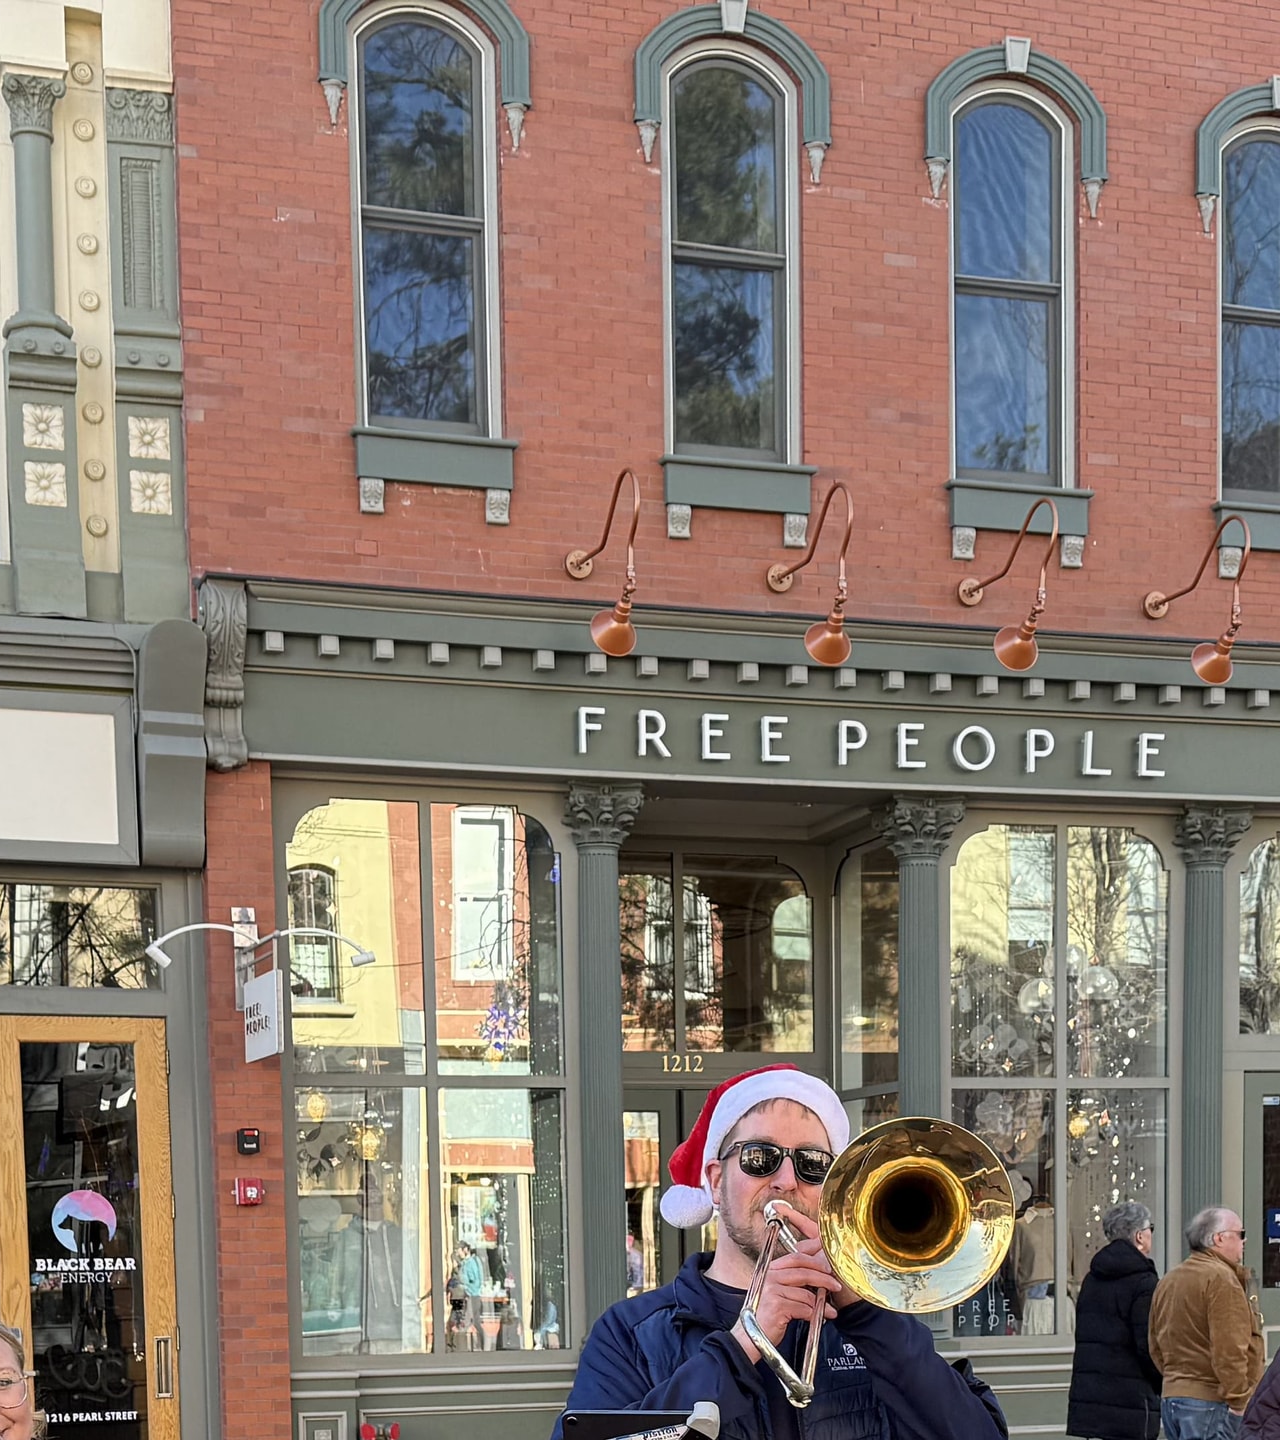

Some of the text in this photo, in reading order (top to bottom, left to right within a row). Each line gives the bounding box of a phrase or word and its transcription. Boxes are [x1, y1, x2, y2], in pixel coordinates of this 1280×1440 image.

[578, 706, 1166, 777] FREE PEOPLE
[246, 1002, 260, 1019] FREE
[246, 1015, 269, 1036] PEOPLE
[662, 1054, 704, 1073] 1212
[35, 1257, 136, 1272] BLACK BEAR
[60, 1272, 113, 1284] ENERGY
[45, 1410, 138, 1423] 1216 PEARL STREET
